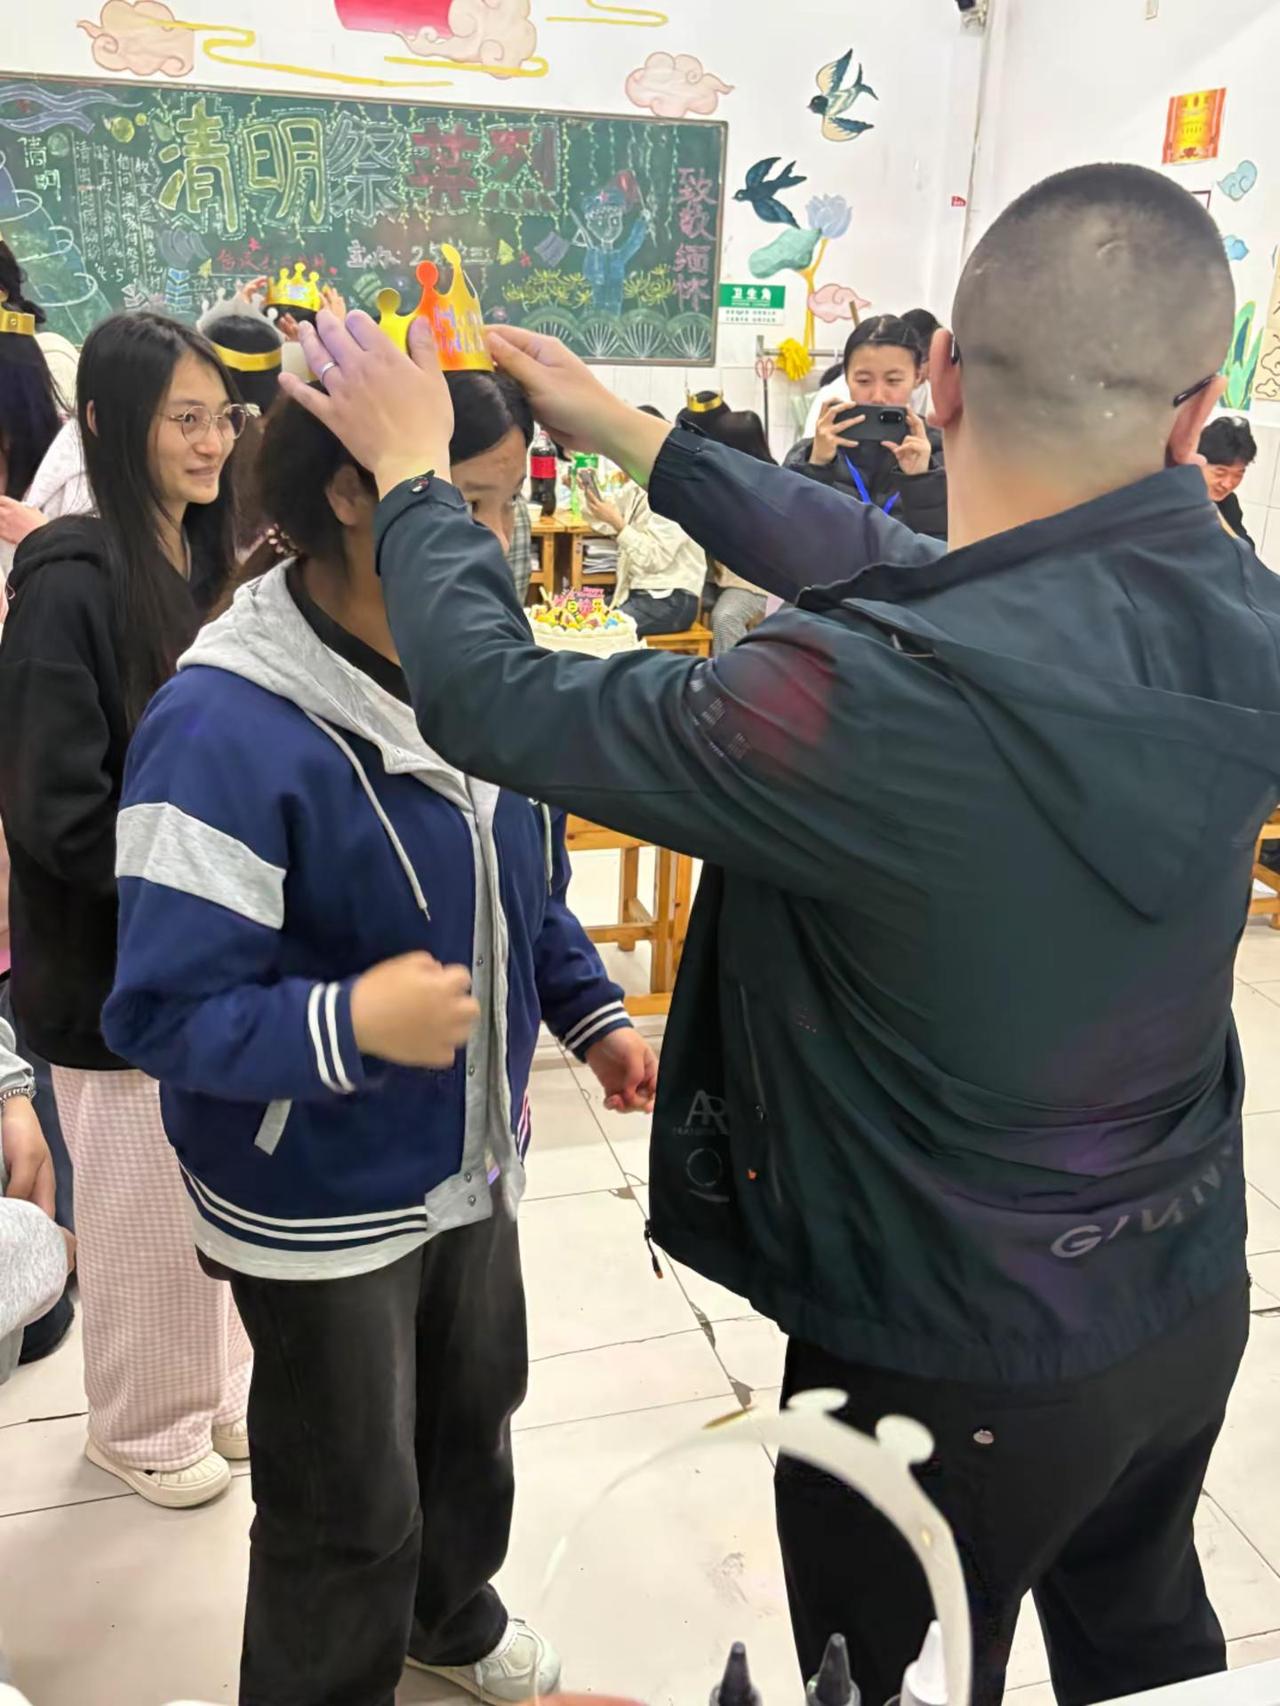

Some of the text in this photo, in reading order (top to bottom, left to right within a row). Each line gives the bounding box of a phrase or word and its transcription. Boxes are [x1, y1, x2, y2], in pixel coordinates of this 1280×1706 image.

[158, 97, 558, 232] 清明祭英烈
